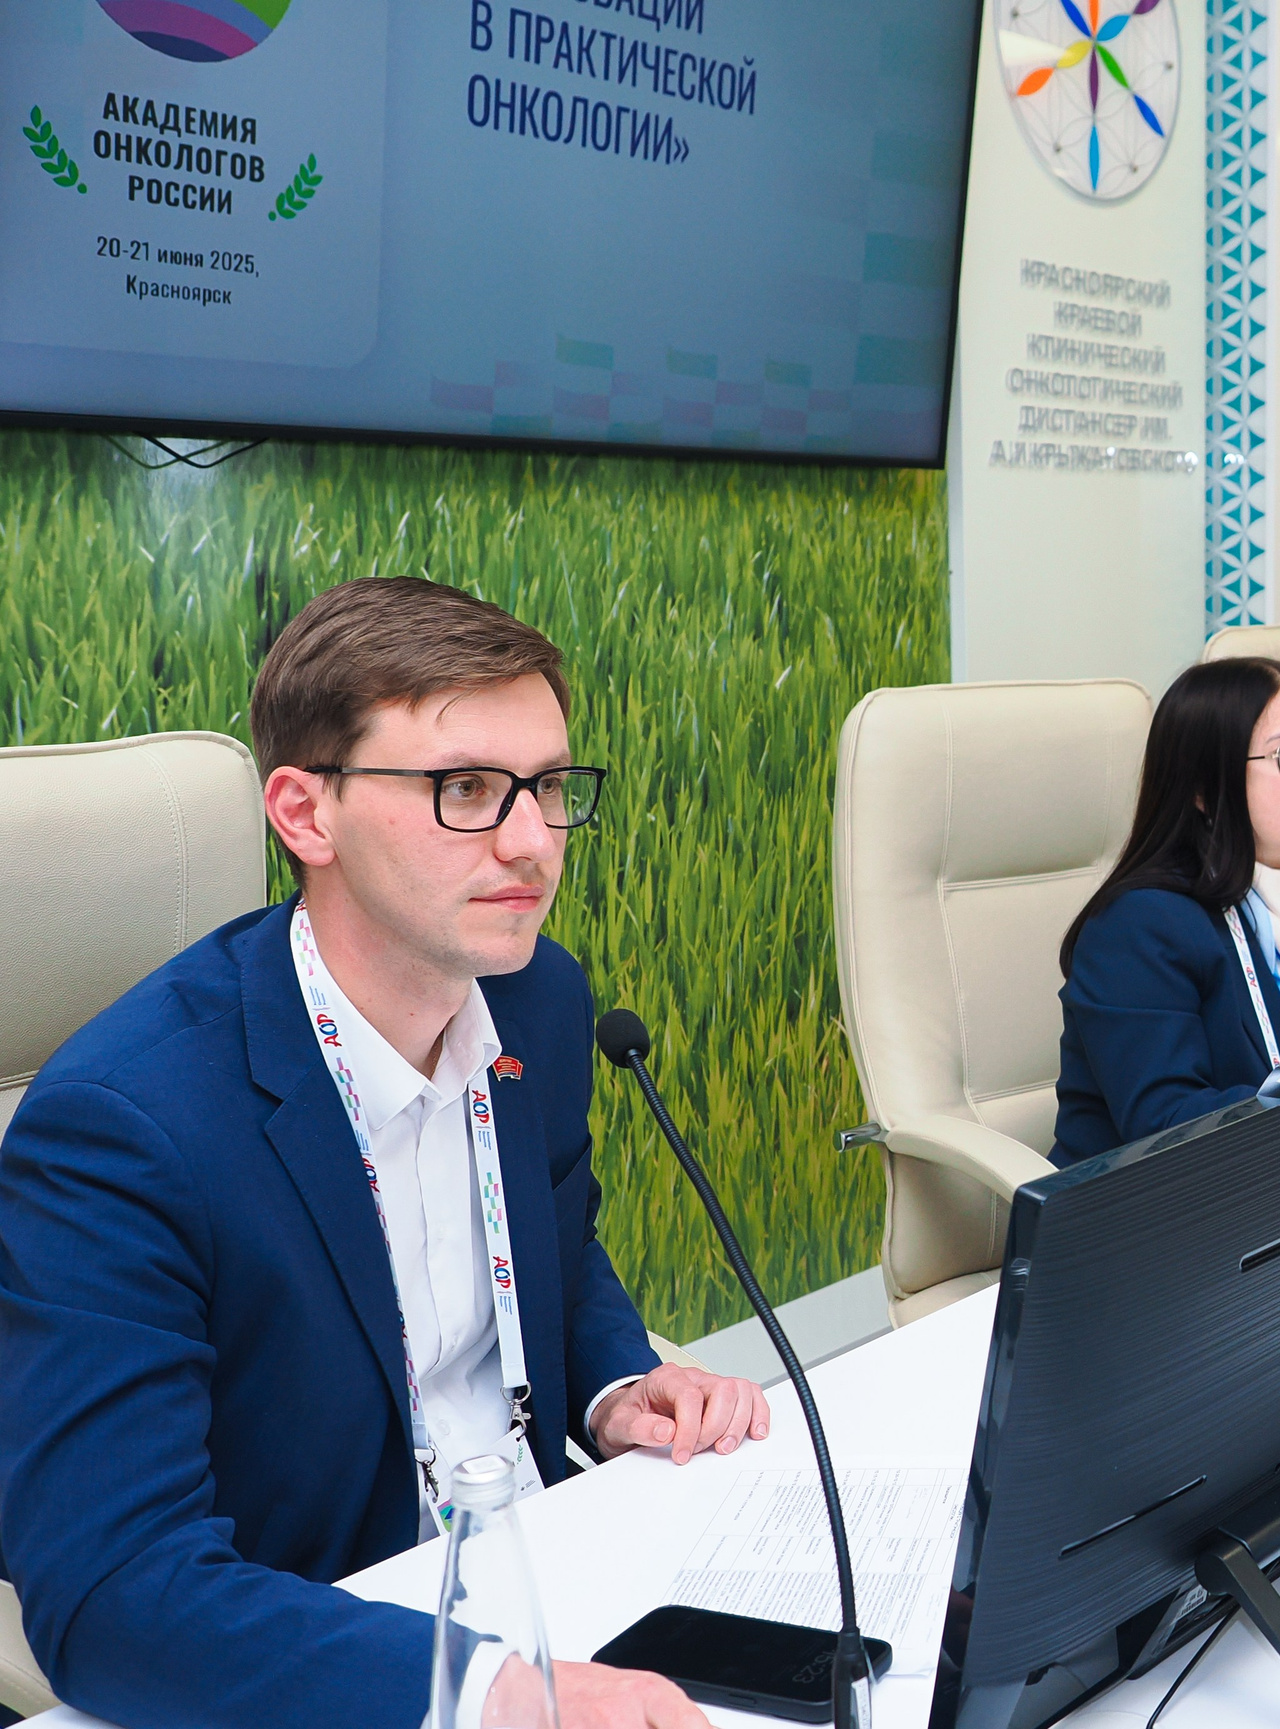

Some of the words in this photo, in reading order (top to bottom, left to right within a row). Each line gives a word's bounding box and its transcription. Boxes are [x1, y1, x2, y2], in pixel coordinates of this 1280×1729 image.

[470, 0, 494, 51] В
[508, 8, 757, 115] ПРАКТИЧЕСКОЙ
[102, 92, 257, 145] АКАДЕМИЯ
[467, 74, 690, 165] ОНКОЛОГИИ»
[93, 129, 265, 183] ОНКОЛОГОВ
[128, 175, 232, 215] РОССИИ
[96, 236, 150, 261] 20-21
[157, 249, 204, 268] июня
[210, 250, 259, 278] 2025,
[126, 274, 232, 307] Красноярск
[1020, 258, 1172, 309] КРАСНОЯРСКИЙ
